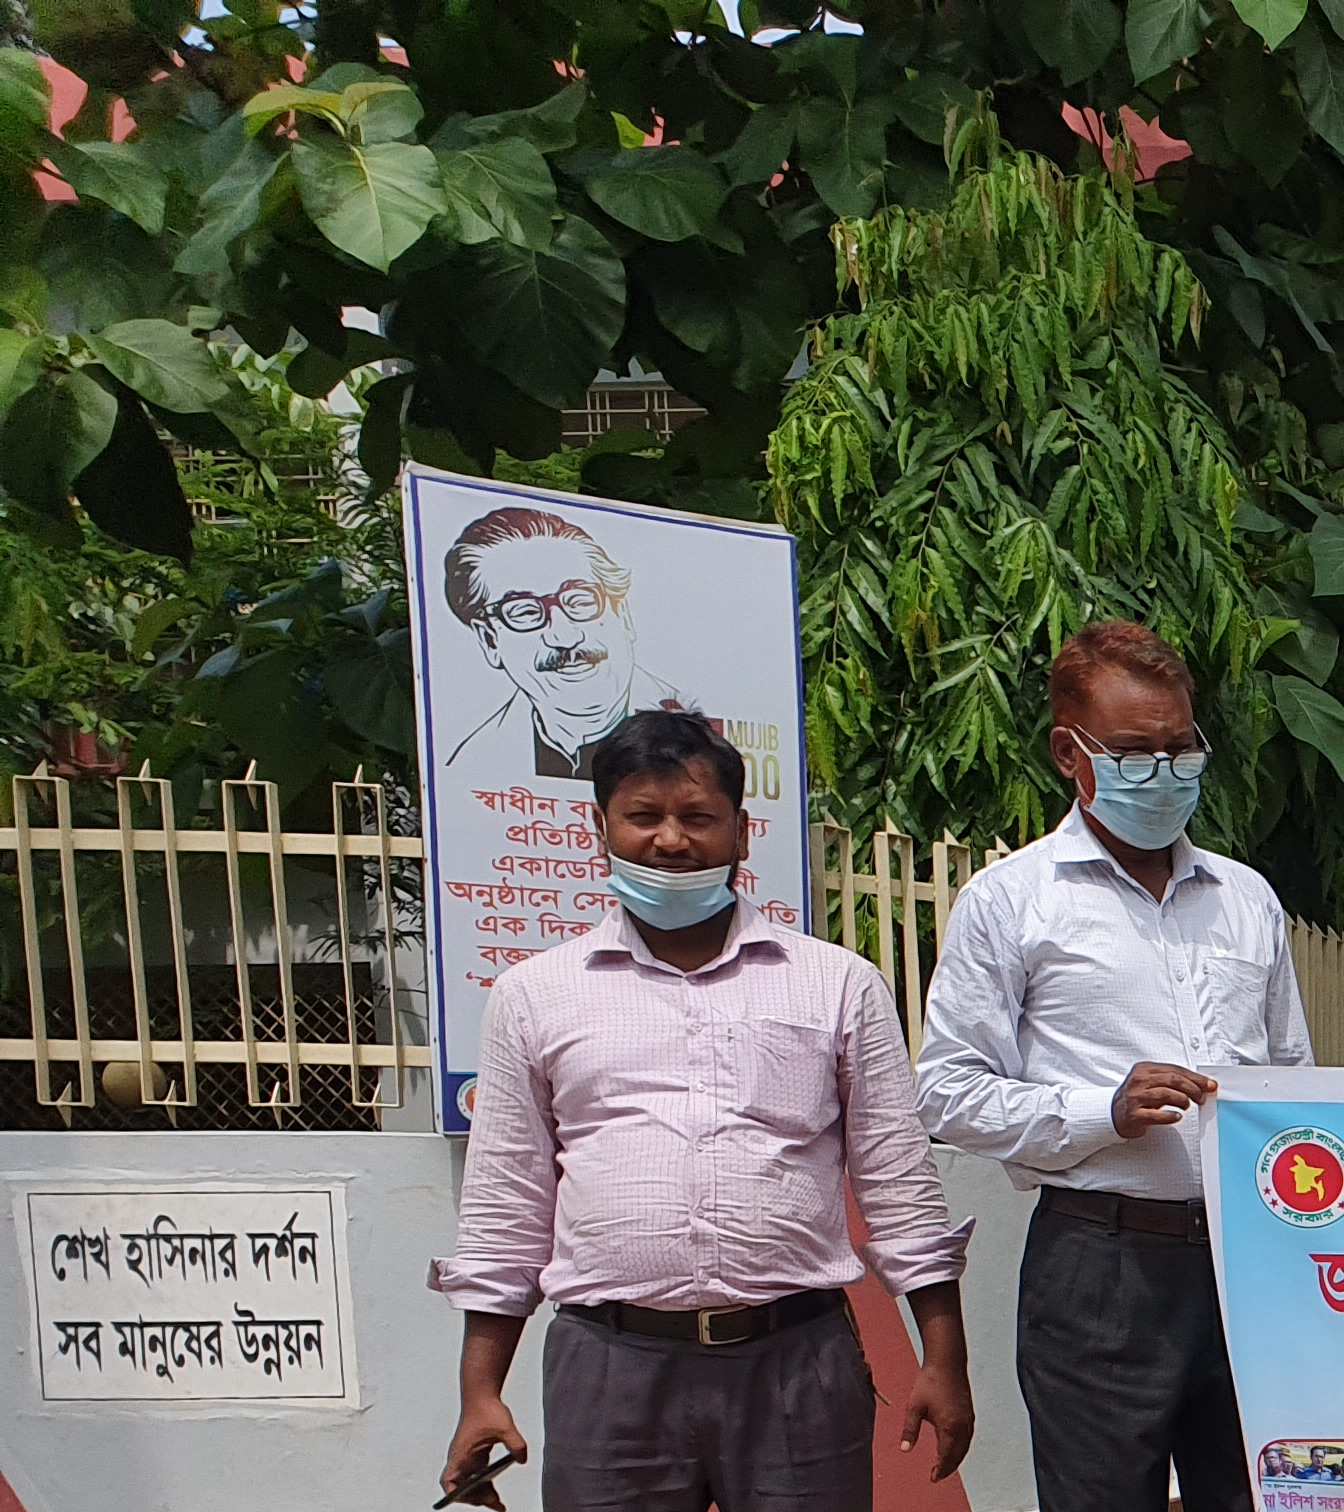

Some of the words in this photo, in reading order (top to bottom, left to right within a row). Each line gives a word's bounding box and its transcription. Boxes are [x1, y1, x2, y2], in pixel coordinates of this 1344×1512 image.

[727, 719, 779, 751] MUJIB
[471, 786, 559, 819] স্বাধীন
[444, 877, 562, 911] অনুষ্ঠানে
[475, 915, 529, 938] এক
[1282, 1206, 1334, 1222] সরকার
[51, 1226, 112, 1283] শেখ
[119, 1214, 238, 1289] হাসিনার
[245, 1211, 319, 1284] দর্শন
[53, 1320, 104, 1373] সব
[110, 1314, 224, 1384] মানুষের
[231, 1302, 325, 1383] উন্নয়ন
